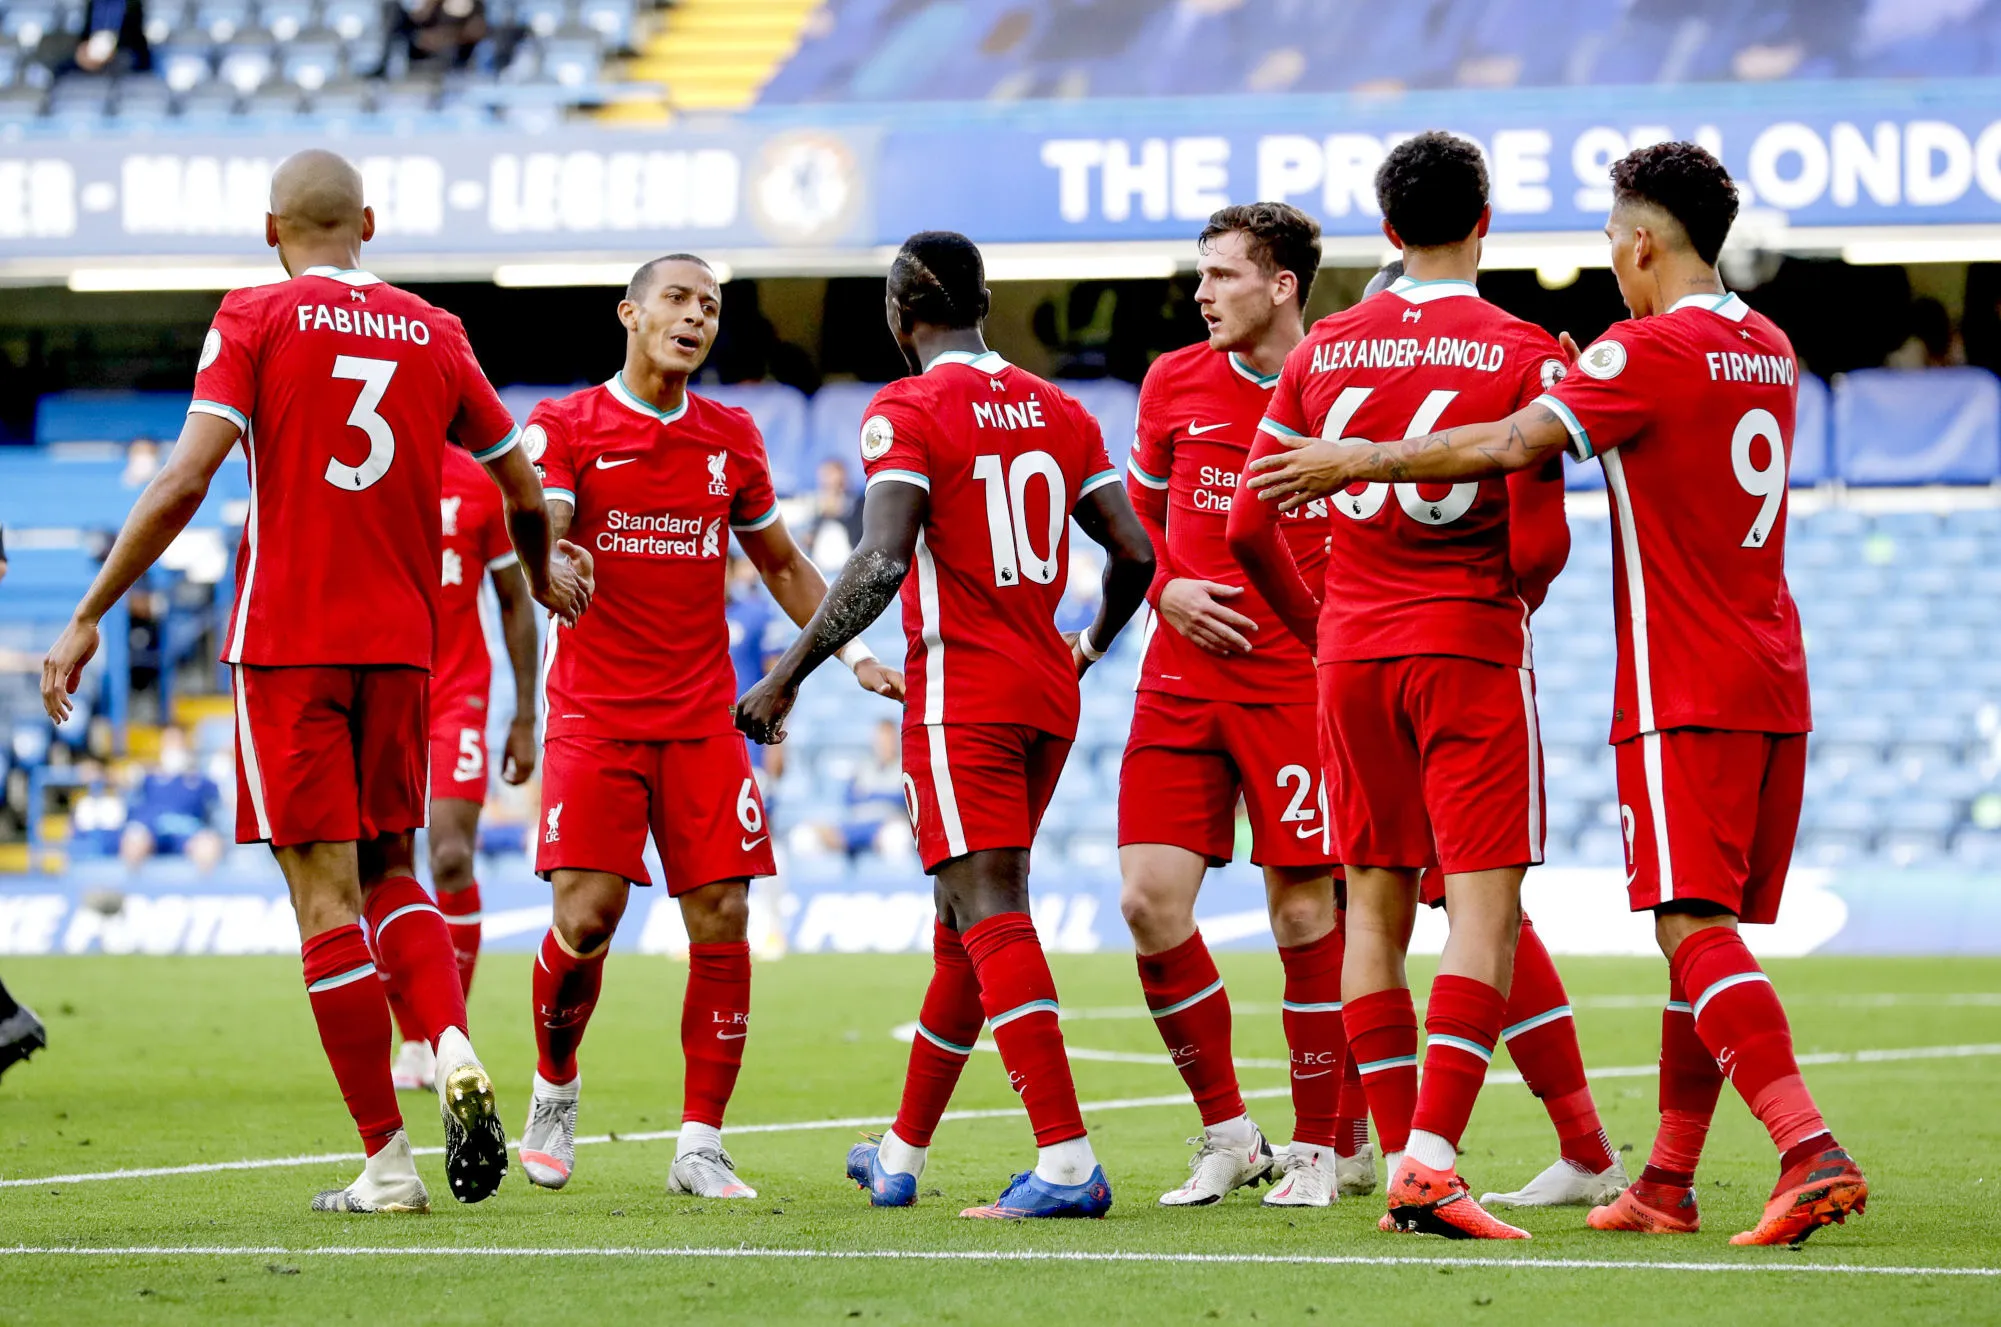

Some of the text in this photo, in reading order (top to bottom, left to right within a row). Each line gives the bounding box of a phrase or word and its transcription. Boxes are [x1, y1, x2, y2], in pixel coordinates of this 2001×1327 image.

[1040, 137, 1230, 222] THE
[1257, 130, 1552, 217] PRE
[298, 305, 430, 346] FABINHO
[1309, 338, 1504, 374] ALEXANDER-ARNOLD
[1705, 351, 1794, 386] FIRMINO
[324, 355, 397, 491] 3
[972, 393, 1046, 431] MANÉ
[1321, 386, 1480, 525] 66
[1731, 408, 1785, 548] 9
[606, 509, 703, 535] Standard
[972, 450, 1066, 588] 10
[596, 532, 697, 557] Chartered
[458, 728, 483, 772] 5
[736, 778, 762, 833] 6
[1276, 763, 1323, 821] 2
